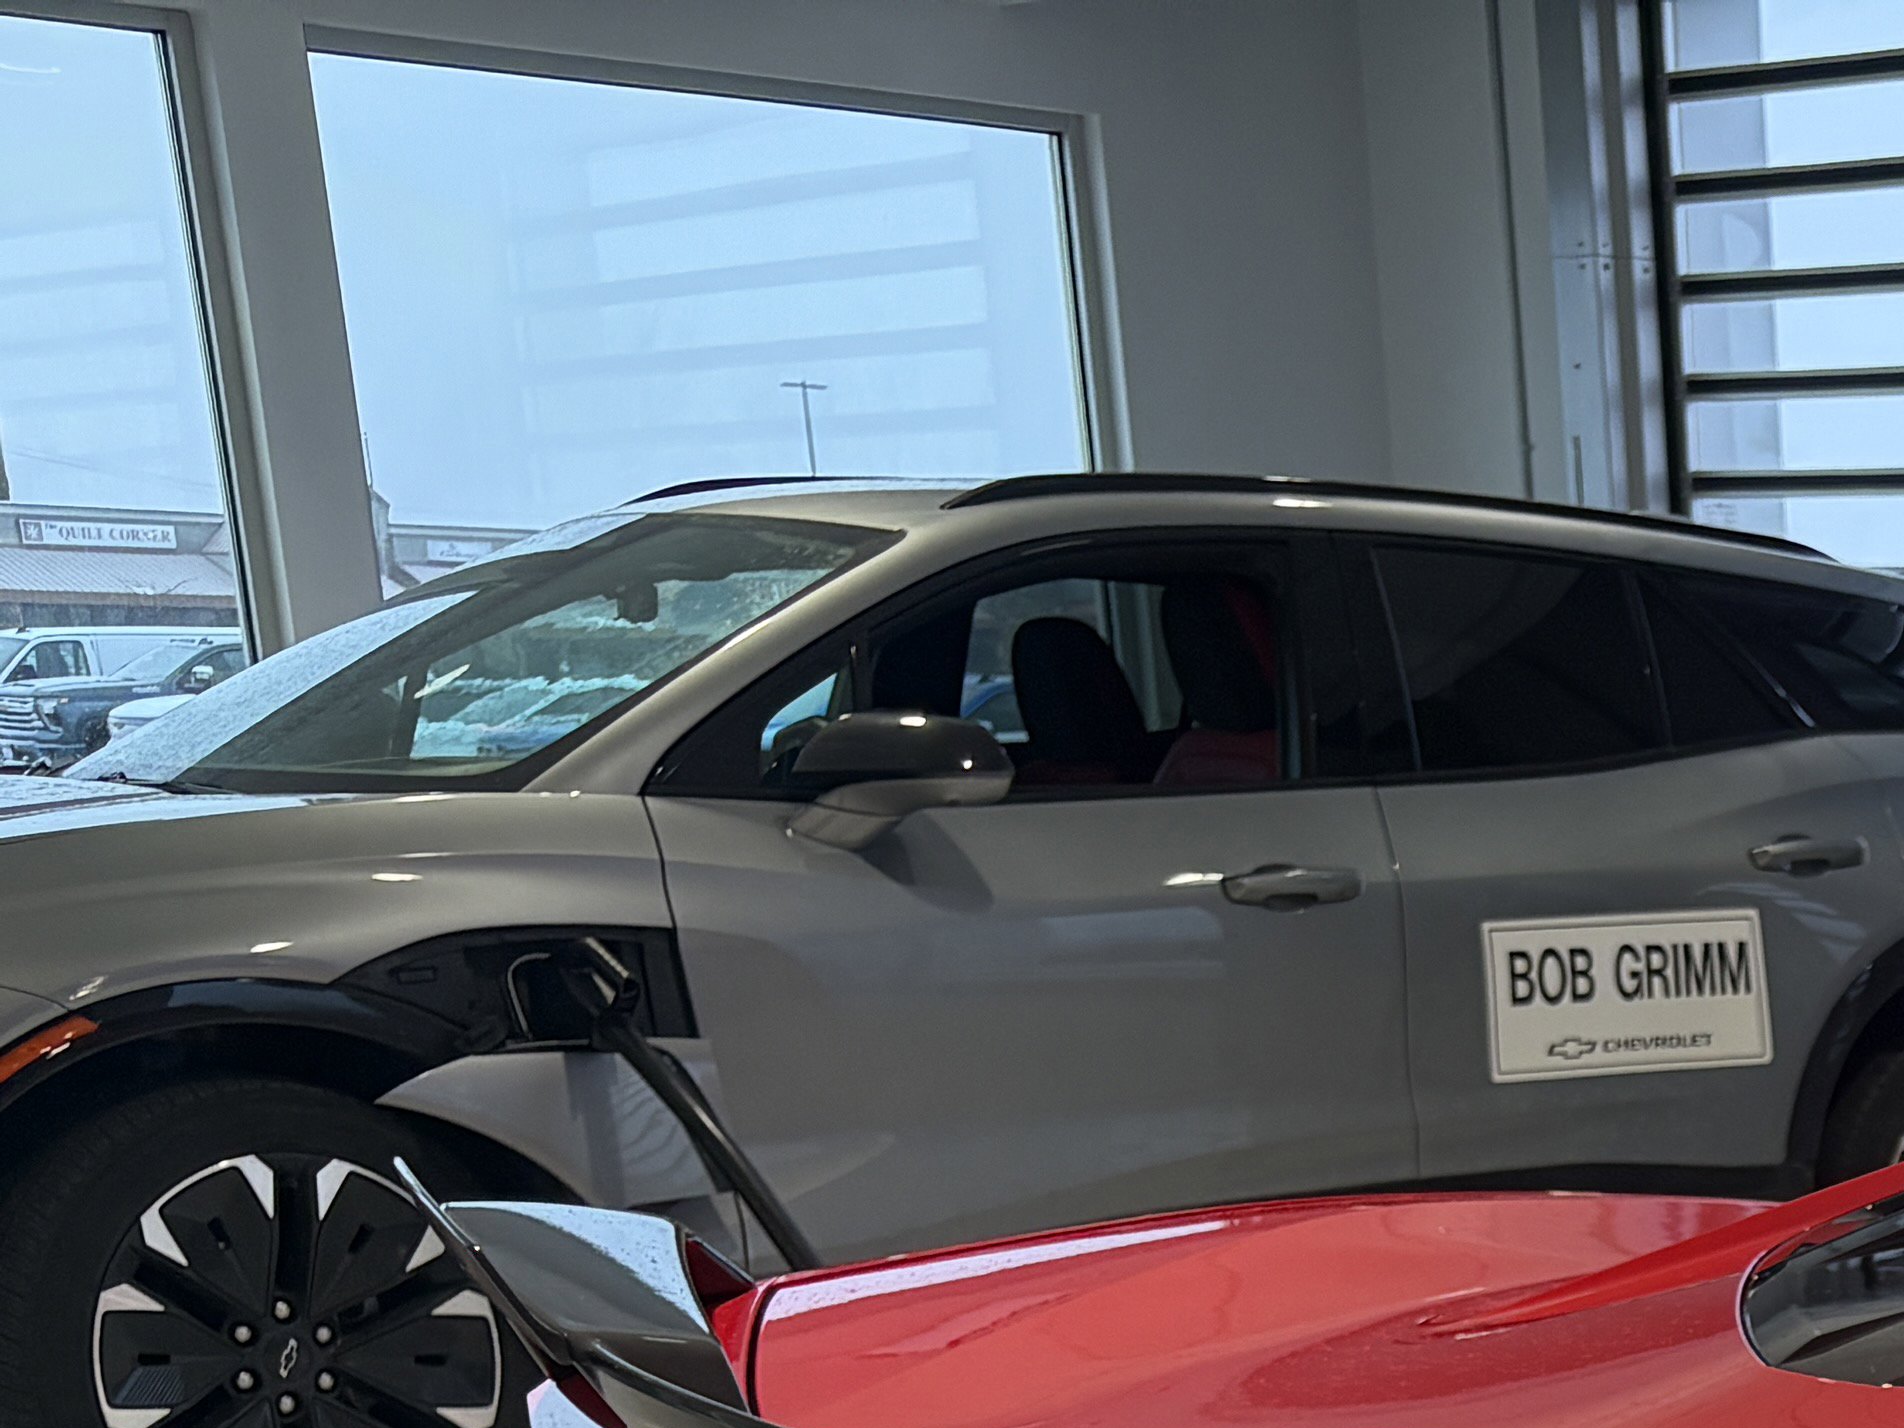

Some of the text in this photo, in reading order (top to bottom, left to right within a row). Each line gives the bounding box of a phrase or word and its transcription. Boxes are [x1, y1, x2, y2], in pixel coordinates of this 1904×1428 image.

[108, 527, 173, 544] CORNER
[1508, 940, 1752, 1007] BOB GRIMM
[1602, 1032, 1713, 1054] CHEVROLET
